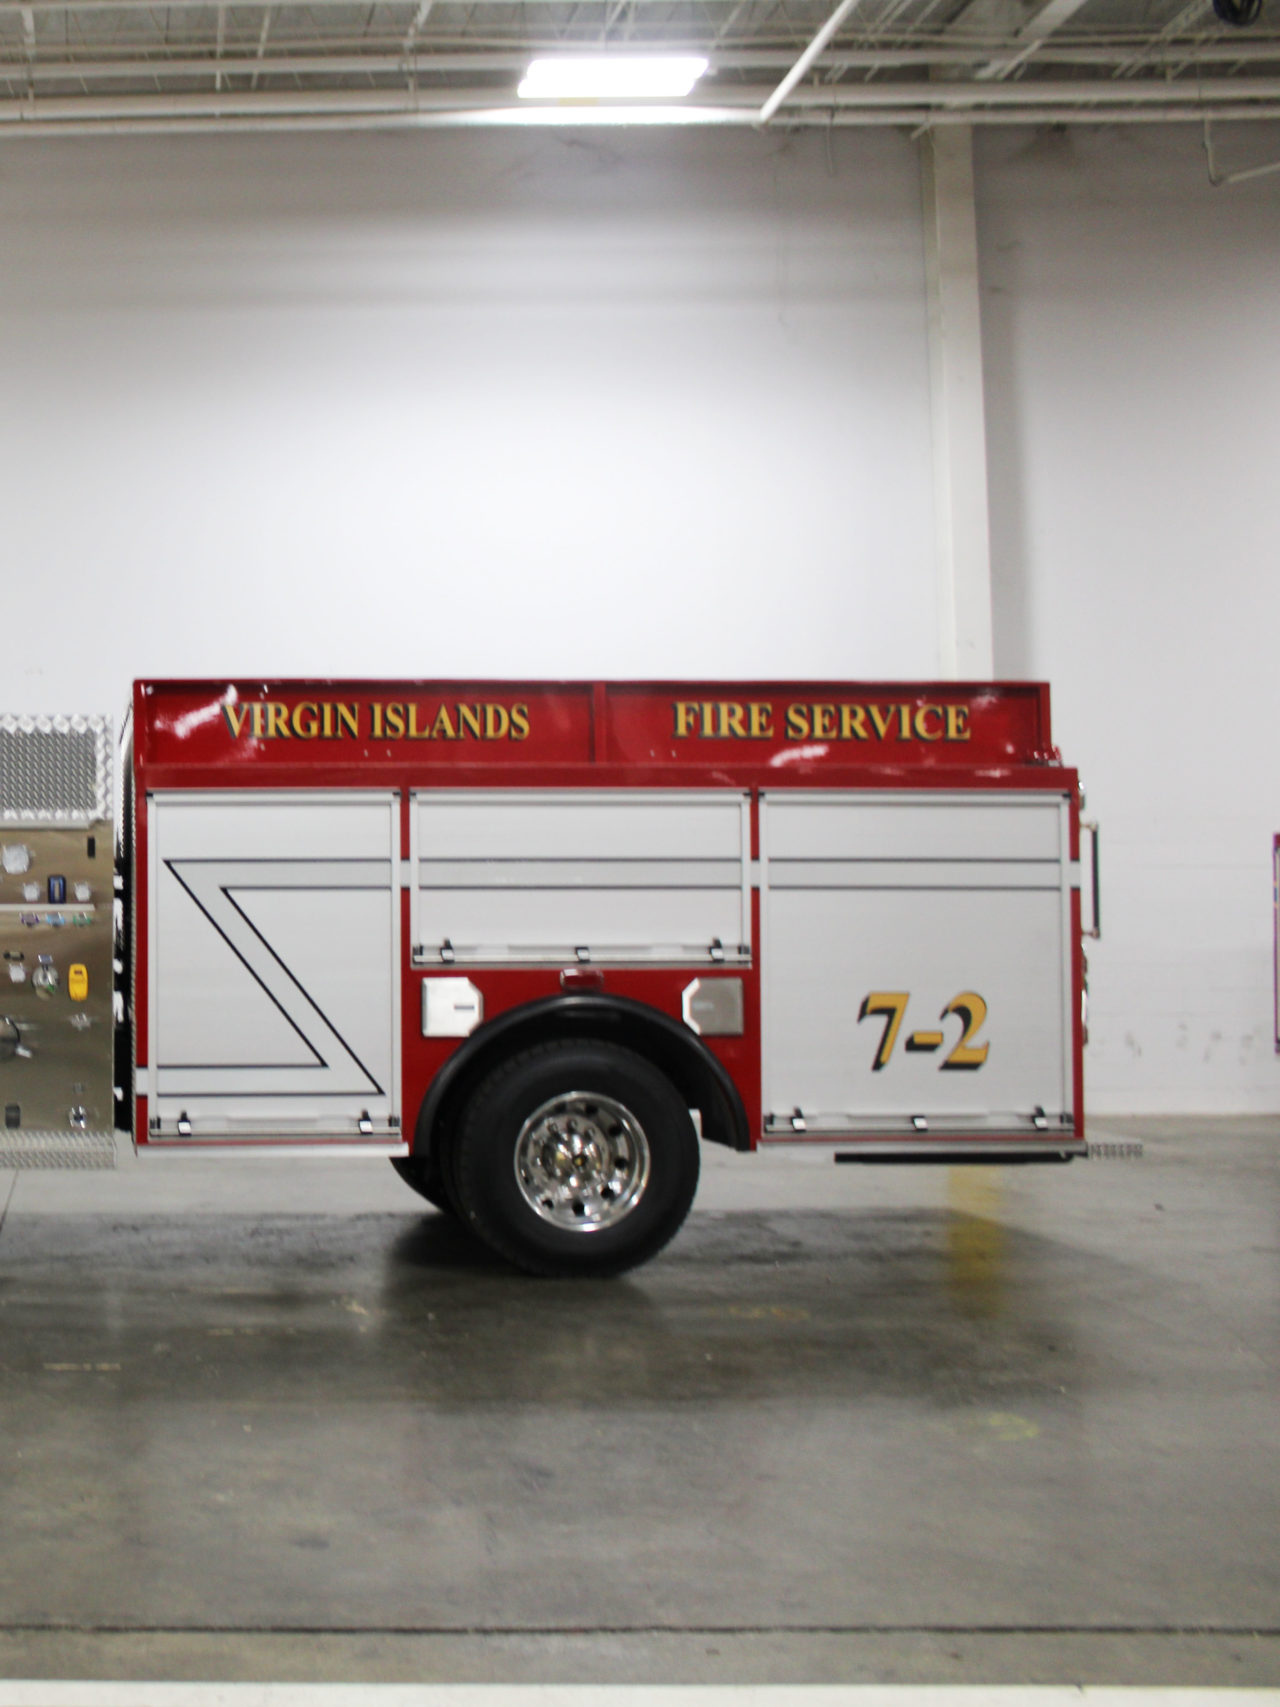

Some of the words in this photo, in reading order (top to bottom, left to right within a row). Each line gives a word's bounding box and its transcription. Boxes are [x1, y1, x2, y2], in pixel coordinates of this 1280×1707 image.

[222, 703, 359, 739] VIRGIN
[369, 704, 530, 740] ISLANDS
[673, 703, 774, 739] FIRE
[785, 704, 971, 741] SERVICE
[857, 991, 990, 1072] 7-2
